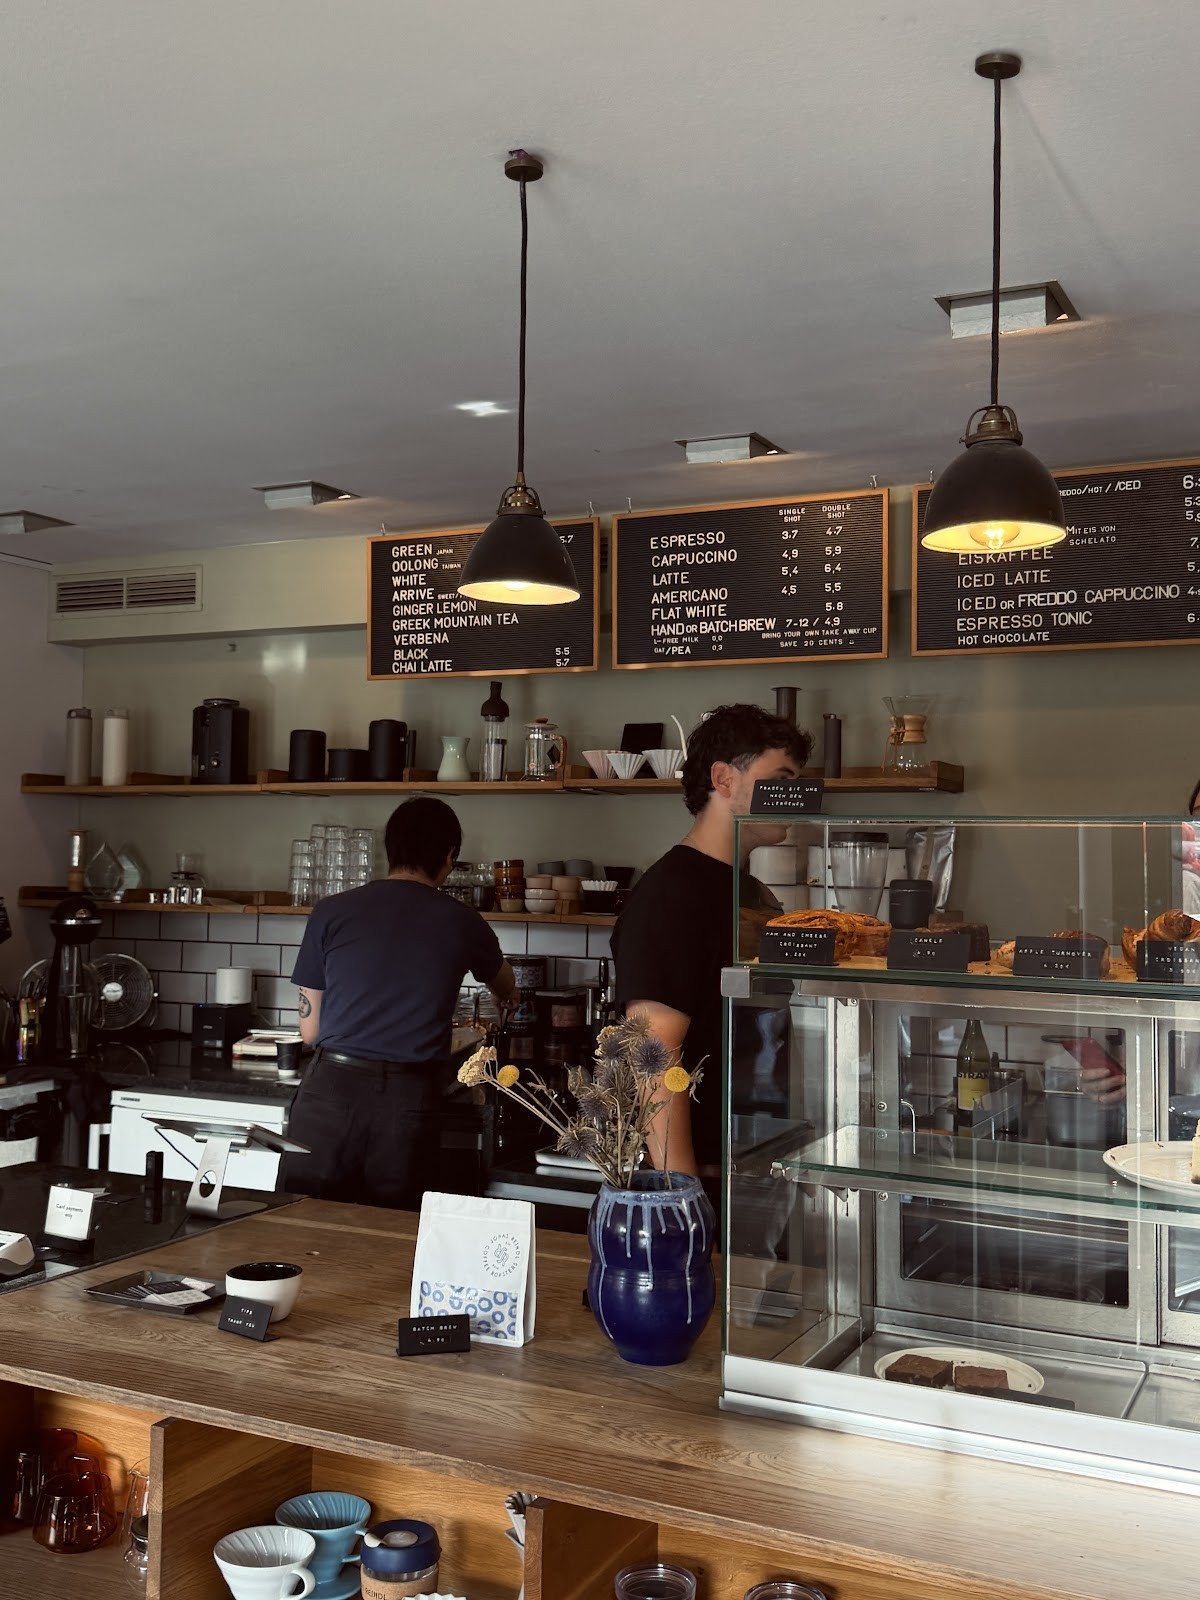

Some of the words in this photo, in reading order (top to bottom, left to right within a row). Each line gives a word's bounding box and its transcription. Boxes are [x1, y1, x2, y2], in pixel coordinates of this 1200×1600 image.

[779, 507, 806, 516] SINGLE
[822, 503, 851, 513] DOUBLE
[784, 515, 801, 523] SHOT
[827, 511, 846, 519] SHOT
[1083, 526, 1097, 534] EIS
[1100, 525, 1116, 533] VON
[650, 531, 725, 549] ESPRESSO
[1069, 535, 1117, 546] SCHELATO
[392, 543, 433, 557] GREEN
[436, 548, 454, 556] JAPAN
[392, 558, 439, 572] OOLONG
[651, 549, 738, 568] CAPPUCCINO
[392, 573, 427, 587] WHITE
[652, 572, 690, 586] LATTE
[957, 573, 995, 588] ICED
[1004, 569, 1051, 586] LATTE
[392, 588, 434, 602] ARRIVE
[651, 588, 728, 605] AMERICANO
[957, 596, 997, 611] ICED
[1000, 600, 1015, 610] OR
[1018, 590, 1077, 608] FREDDO
[1085, 584, 1180, 603] CAPPUCCINO
[392, 602, 434, 617] GINGER
[436, 600, 477, 614] LEMON
[651, 607, 683, 621] FLAT
[685, 604, 727, 618] WHITE
[392, 617, 431, 631] GREEK
[433, 614, 493, 629] MOUNTAIN
[496, 613, 519, 625] TEA
[651, 622, 685, 636] HAND
[686, 624, 698, 633] OR
[785, 618, 809, 628] 7-12
[957, 614, 1043, 632] ESPRESSO
[1051, 611, 1093, 626] TONIC
[393, 632, 450, 646] VERBENA
[682, 635, 699, 644] MILK
[761, 631, 782, 639] BRING
[784, 630, 801, 638] YOUR
[804, 629, 820, 637] OWN
[821, 628, 840, 636] TAKE
[862, 626, 878, 634] CUP
[958, 635, 979, 645] HOT
[983, 631, 1050, 644] CHOCOLATE
[779, 640, 798, 648] SAVE
[803, 639, 815, 647] 20
[818, 638, 843, 646] CENTS
[393, 648, 429, 660] BLACK
[392, 660, 417, 673] CHAI
[420, 659, 453, 672] LATTE
